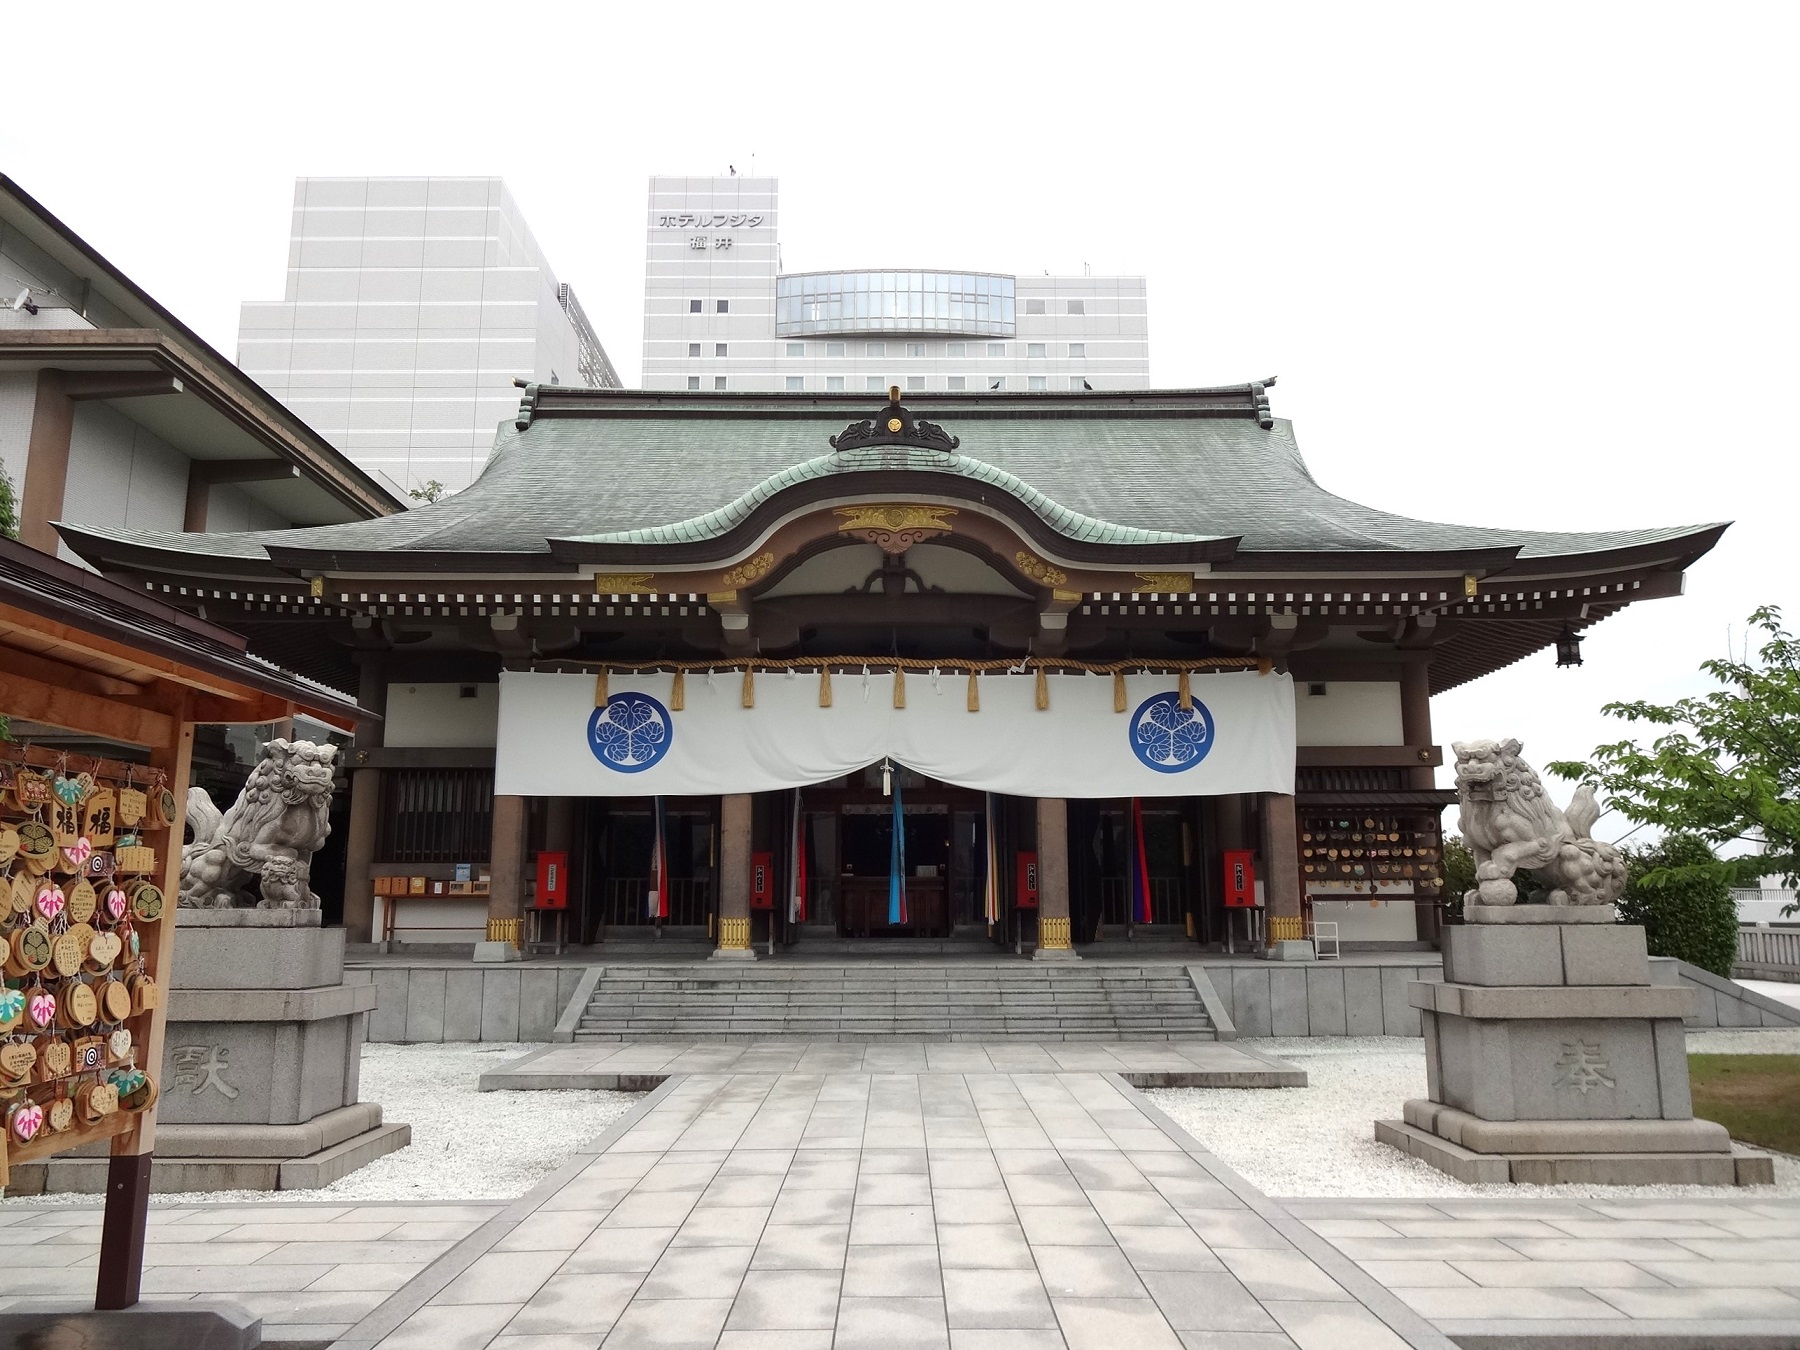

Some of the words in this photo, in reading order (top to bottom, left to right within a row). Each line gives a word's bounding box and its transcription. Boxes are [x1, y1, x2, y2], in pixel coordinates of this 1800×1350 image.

[660, 214, 764, 228] ホテルフジタ
[89, 807, 112, 836] 福
[1551, 1038, 1617, 1095] 奉
